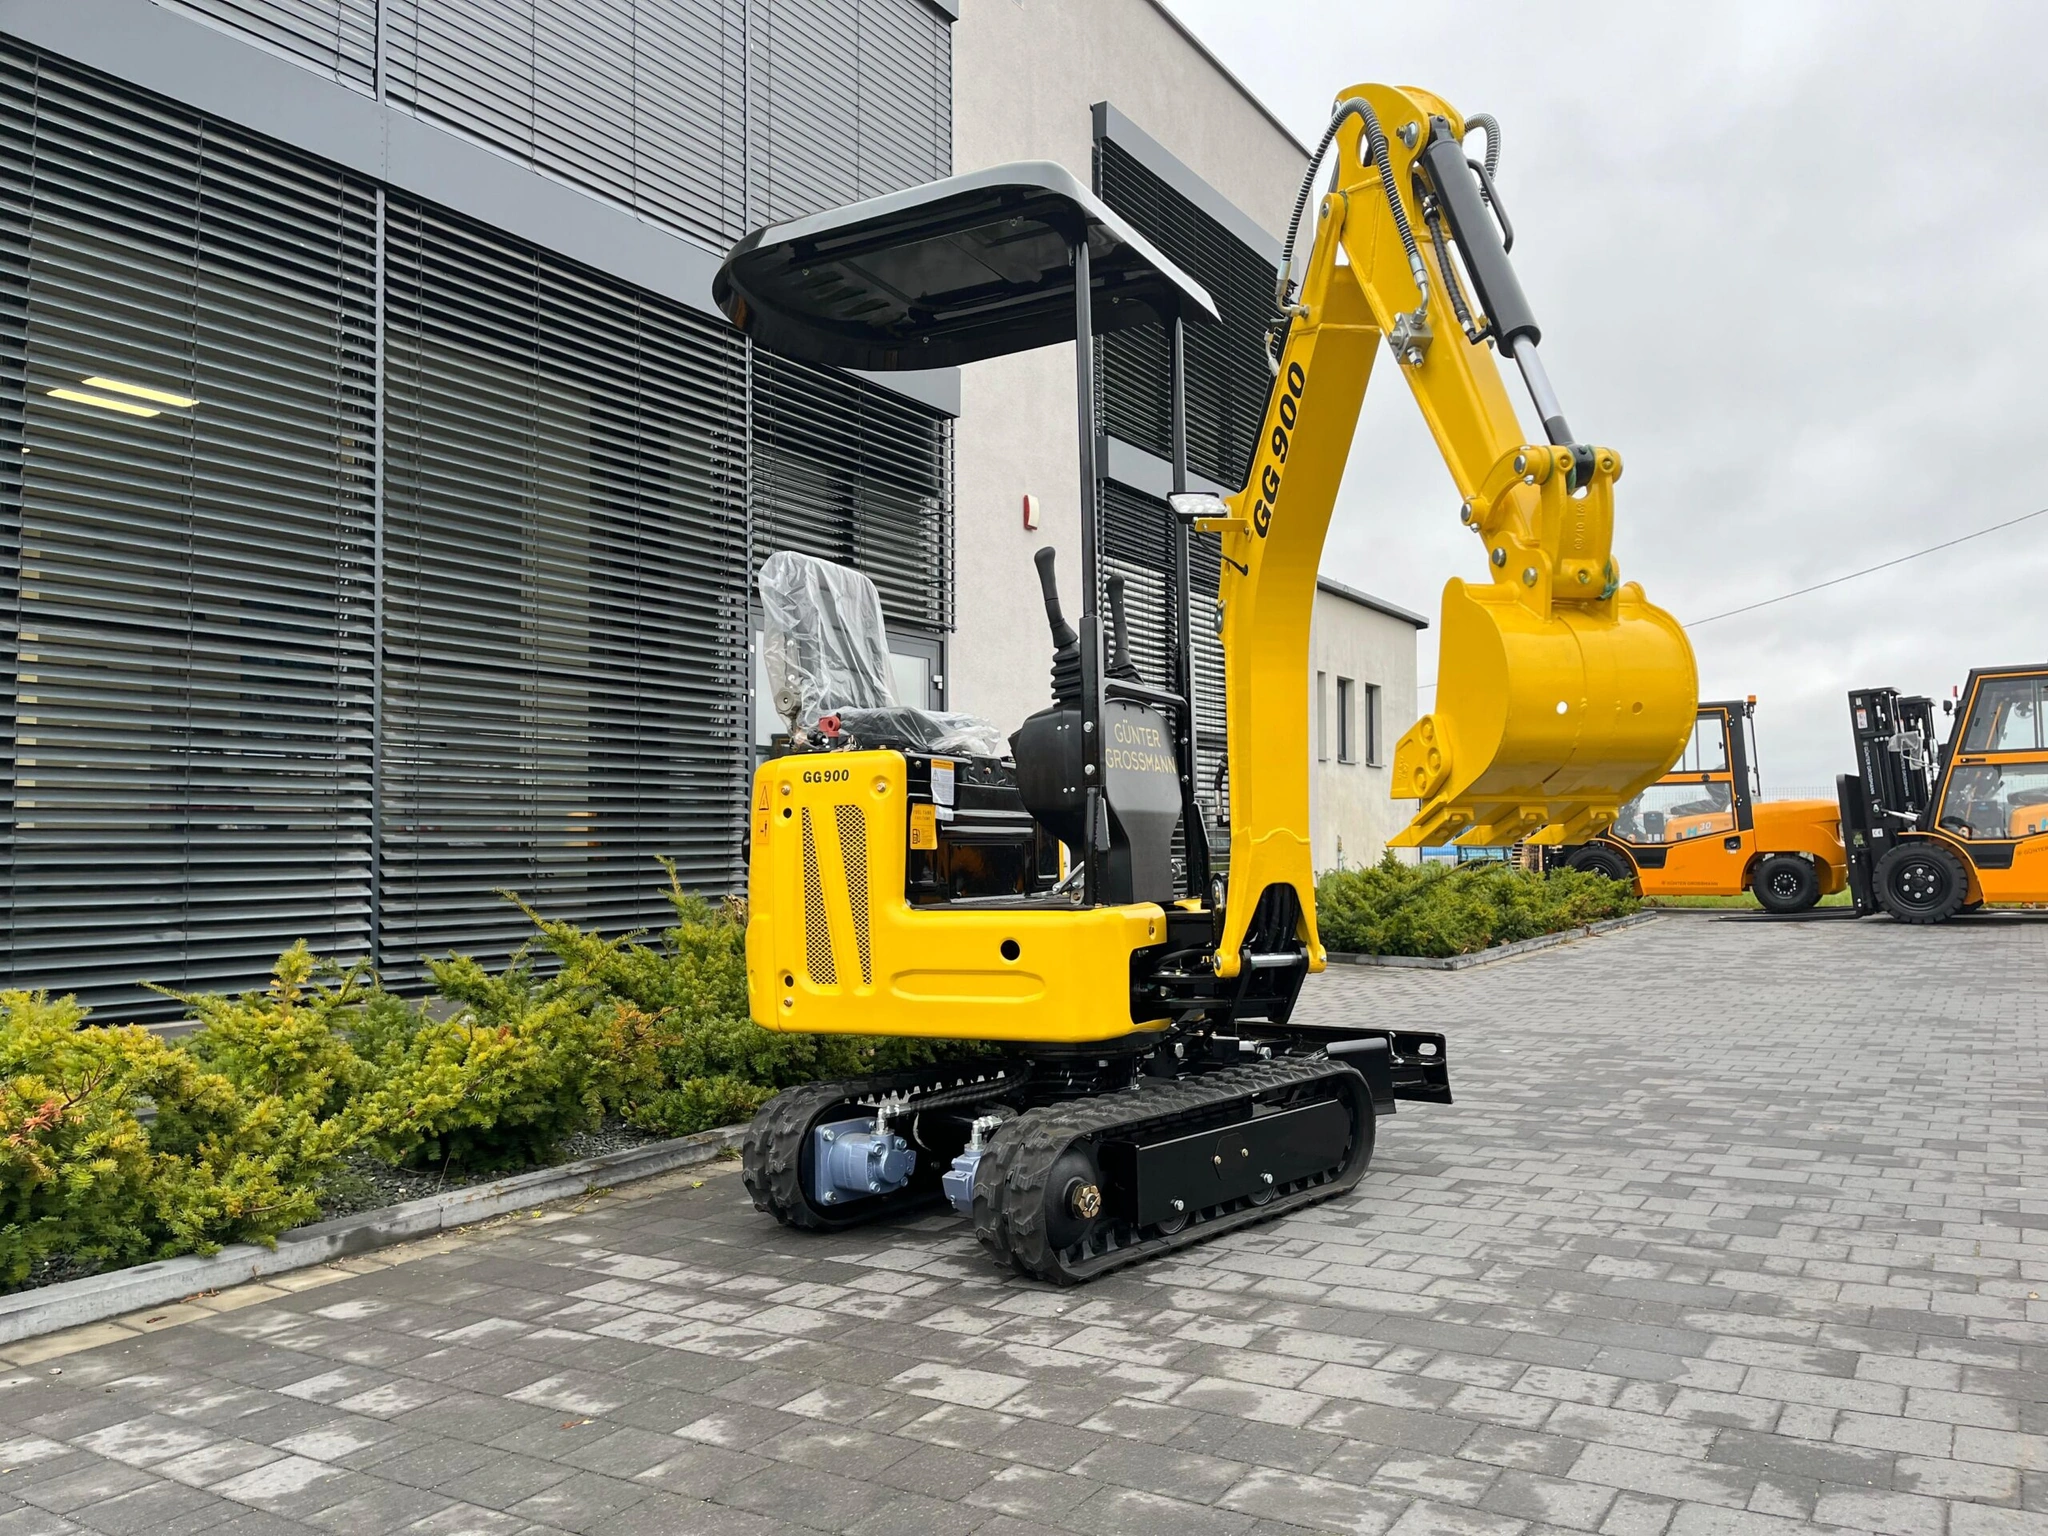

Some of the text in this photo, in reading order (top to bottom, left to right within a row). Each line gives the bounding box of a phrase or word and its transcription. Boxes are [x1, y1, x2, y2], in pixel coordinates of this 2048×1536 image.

[1254, 362, 1305, 538] GG 900
[1114, 719, 1161, 747] GÜNTER
[1105, 748, 1177, 774] GROSSMANN
[1866, 766, 1875, 795] GROSSMANN
[1700, 821, 1711, 831] 30
